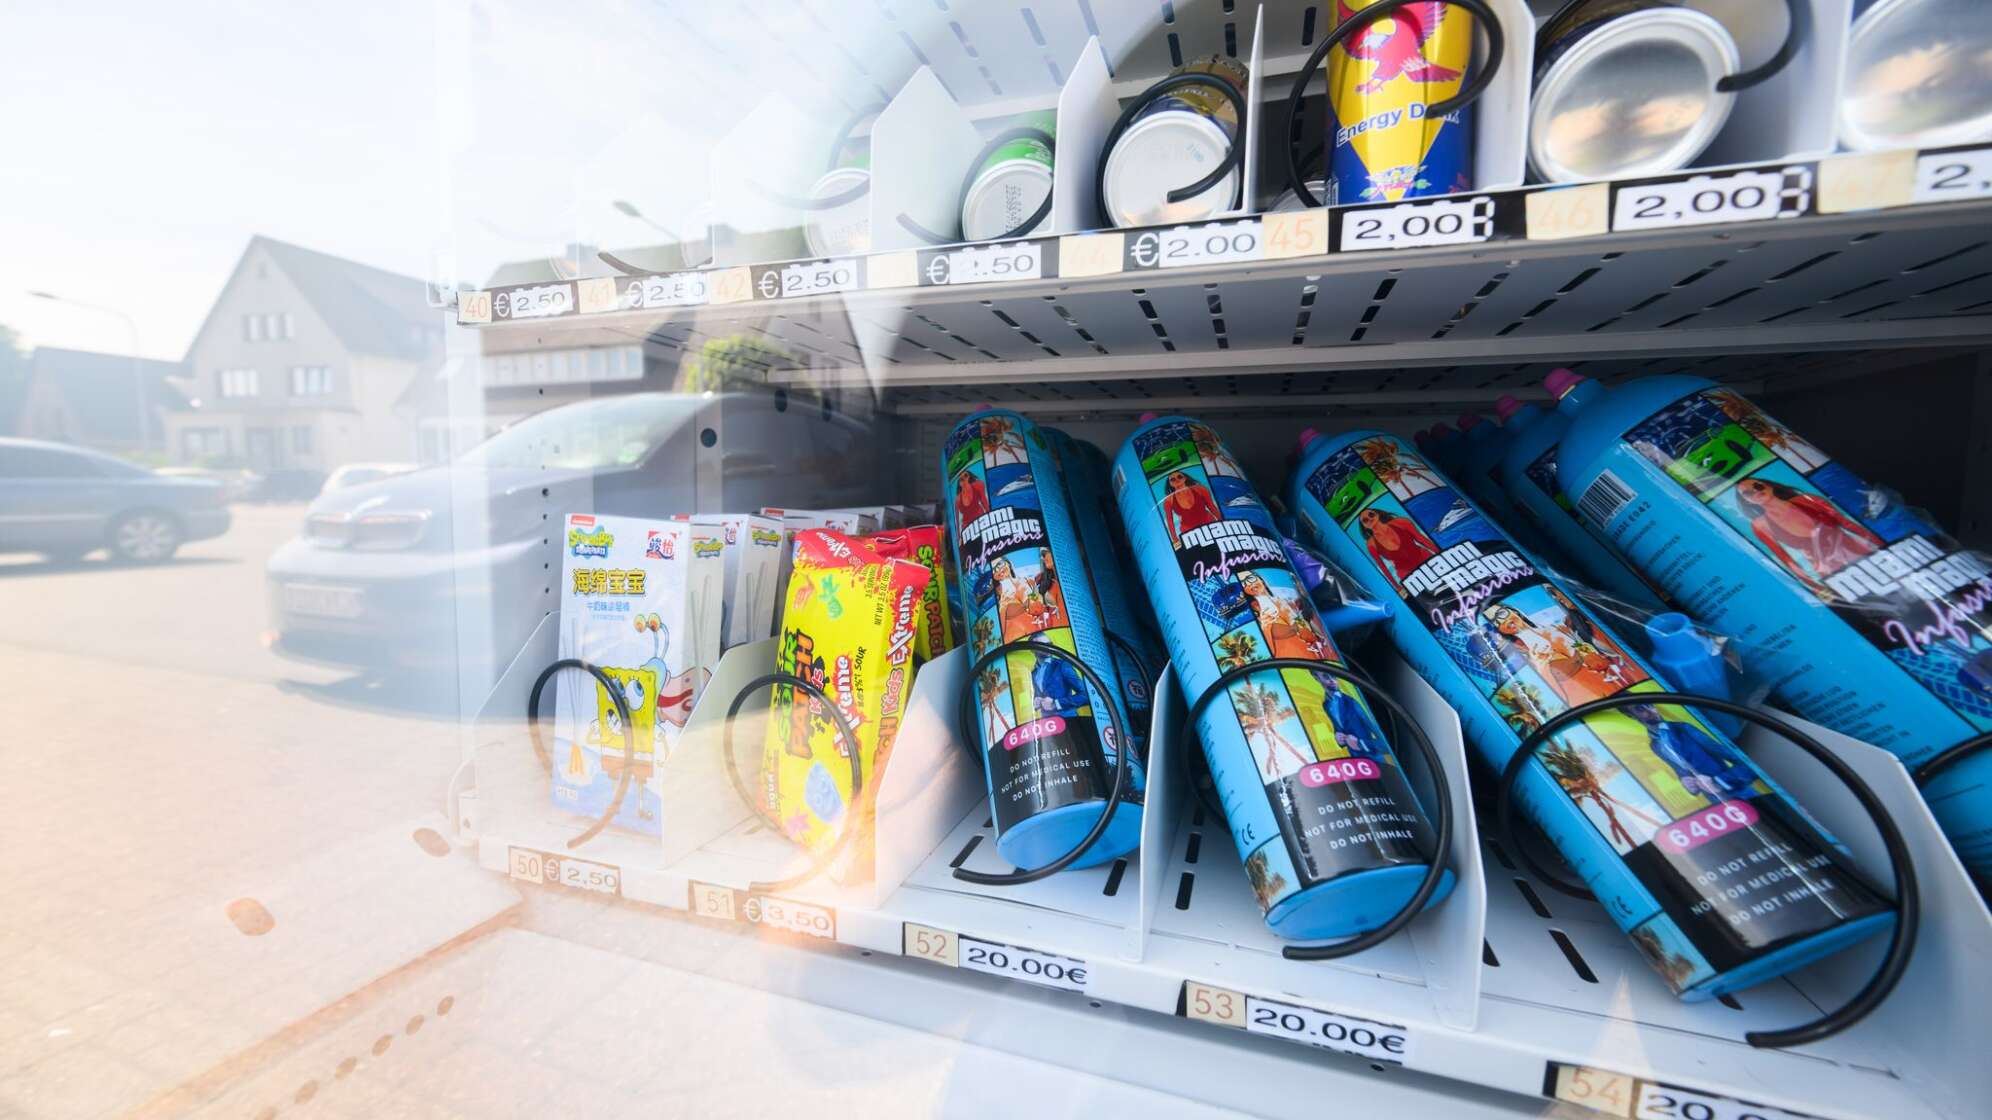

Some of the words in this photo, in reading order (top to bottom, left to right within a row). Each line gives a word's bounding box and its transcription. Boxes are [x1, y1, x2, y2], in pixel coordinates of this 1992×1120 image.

[1336, 107, 1402, 147] Energy
[1633, 185, 1766, 220] 2,00
[1268, 217, 1313, 251] 45
[1355, 213, 1463, 244] 2,00
[1130, 233, 1160, 267] €
[1166, 233, 1257, 259] 2.00
[757, 270, 780, 299] €
[786, 268, 851, 292] 2.50
[926, 254, 950, 285] €
[968, 253, 1036, 277] .50
[586, 281, 611, 306] 41
[625, 281, 643, 307] €
[649, 280, 706, 303] 2.50
[713, 273, 747, 300] 42
[464, 299, 488, 319] 40
[493, 292, 511, 318] €
[516, 290, 567, 313] 2.50
[924, 601, 945, 660] PATC
[854, 646, 867, 671] SOUR
[1008, 719, 1057, 746] 640G
[1009, 763, 1020, 774] DO
[1021, 755, 1039, 769] NOT
[1041, 748, 1070, 761] REFILL
[1309, 760, 1373, 784] 640G
[1001, 782, 1015, 794] NOT
[1014, 773, 1030, 786] FOR
[1031, 762, 1071, 779] MEDICAL
[1072, 759, 1090, 769] USE
[1012, 792, 1023, 803] DO
[1024, 784, 1042, 797] NOT
[1044, 774, 1078, 790] INHALE
[1317, 804, 1334, 816] DO
[1338, 799, 1360, 811] NOT
[1363, 797, 1395, 807] REFILL
[1305, 825, 1327, 838] NOT
[1329, 819, 1352, 831] FOR
[1355, 813, 1400, 825] MEDICAL
[1329, 837, 1346, 850] DO
[1349, 831, 1375, 845] NOT
[1376, 829, 1414, 842] INHALE
[1670, 804, 1748, 848] 640G
[518, 855, 538, 877] 50
[545, 857, 560, 881] €
[567, 867, 617, 888] 2.50
[1696, 872, 1718, 887] DO
[1720, 858, 1747, 877] NOT
[707, 892, 731, 914] 51
[744, 898, 763, 922] €
[1691, 898, 1716, 917] NOT
[1718, 883, 1748, 902] FOR
[1728, 910, 1751, 926] DO
[1752, 896, 1783, 917] NOT
[916, 930, 948, 960] 52
[967, 947, 1088, 985] 20.00€
[1194, 989, 1234, 1019] 53
[1253, 1007, 1407, 1055] 20.00€
[1569, 1068, 1621, 1106] 54
